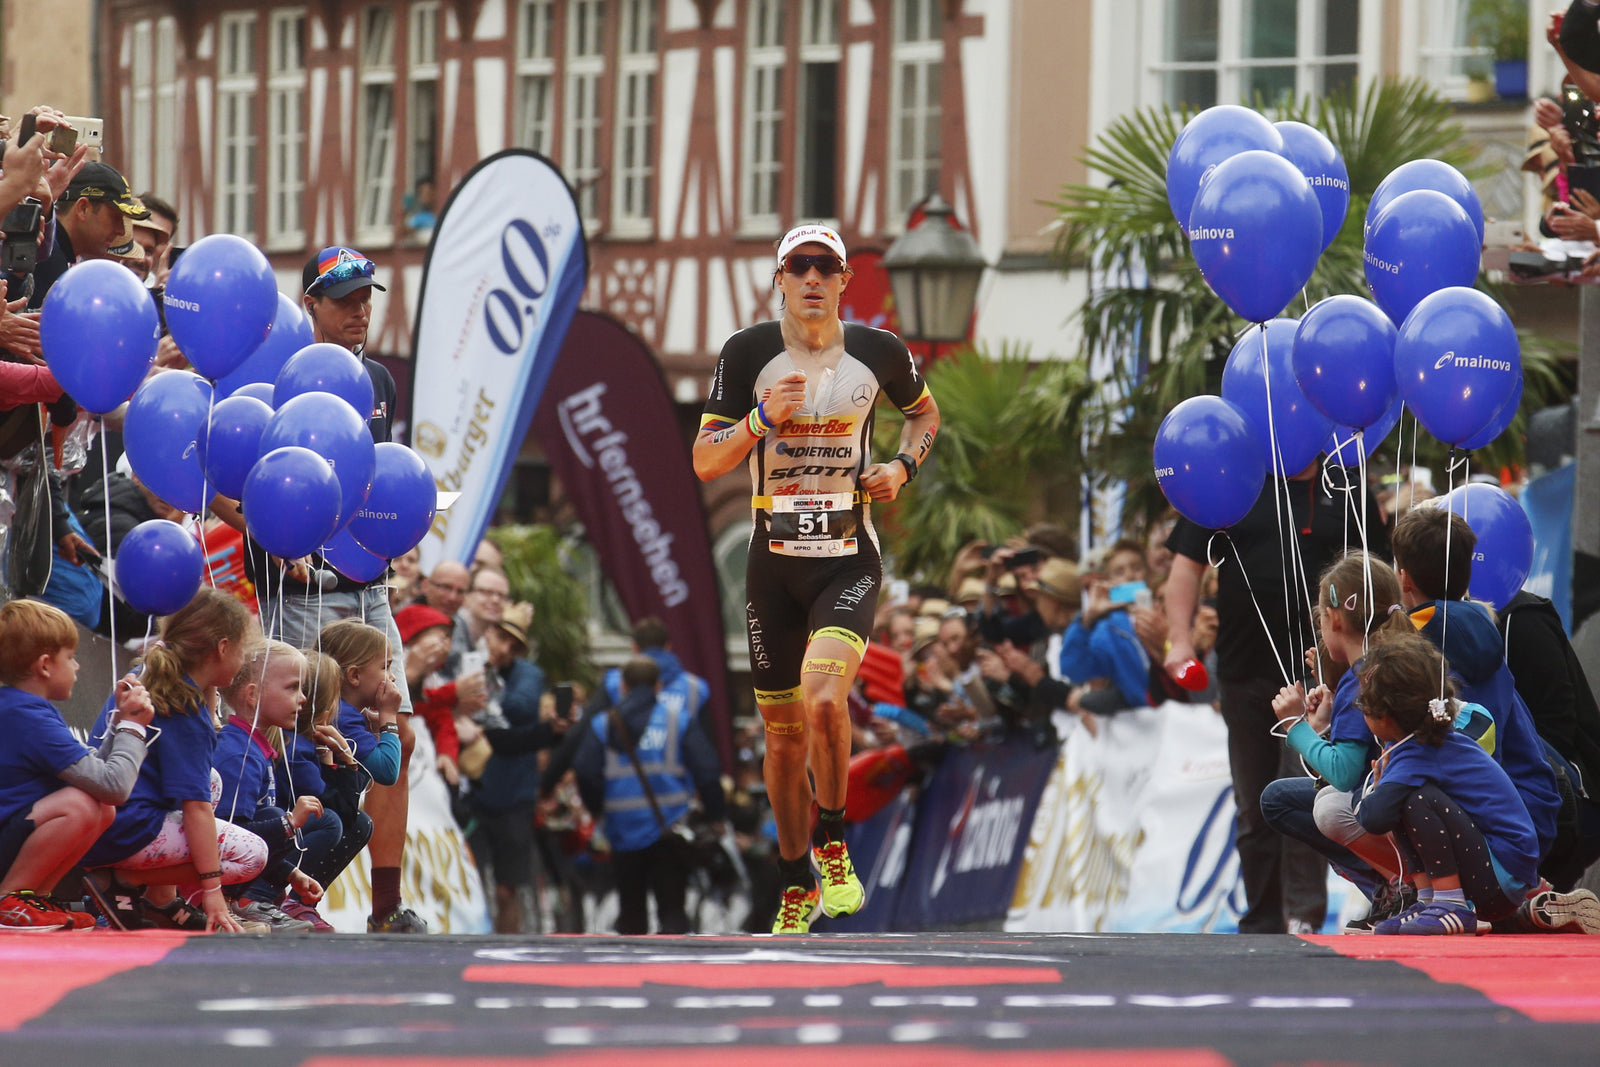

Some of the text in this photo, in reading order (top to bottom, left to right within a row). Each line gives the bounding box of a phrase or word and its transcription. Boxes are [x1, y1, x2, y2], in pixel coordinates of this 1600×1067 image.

[788, 231, 800, 243] Red
[1454, 355, 1511, 372] mainova
[780, 419, 854, 435] PowerBar
[793, 446, 853, 458] DIETRICH
[768, 465, 856, 480] SCOTT
[356, 508, 398, 520] ainova
[592, 430, 690, 608] fernsehen
[797, 512, 829, 534] 51
[833, 575, 875, 612] V-Klasse
[804, 661, 845, 674] PowerBar
